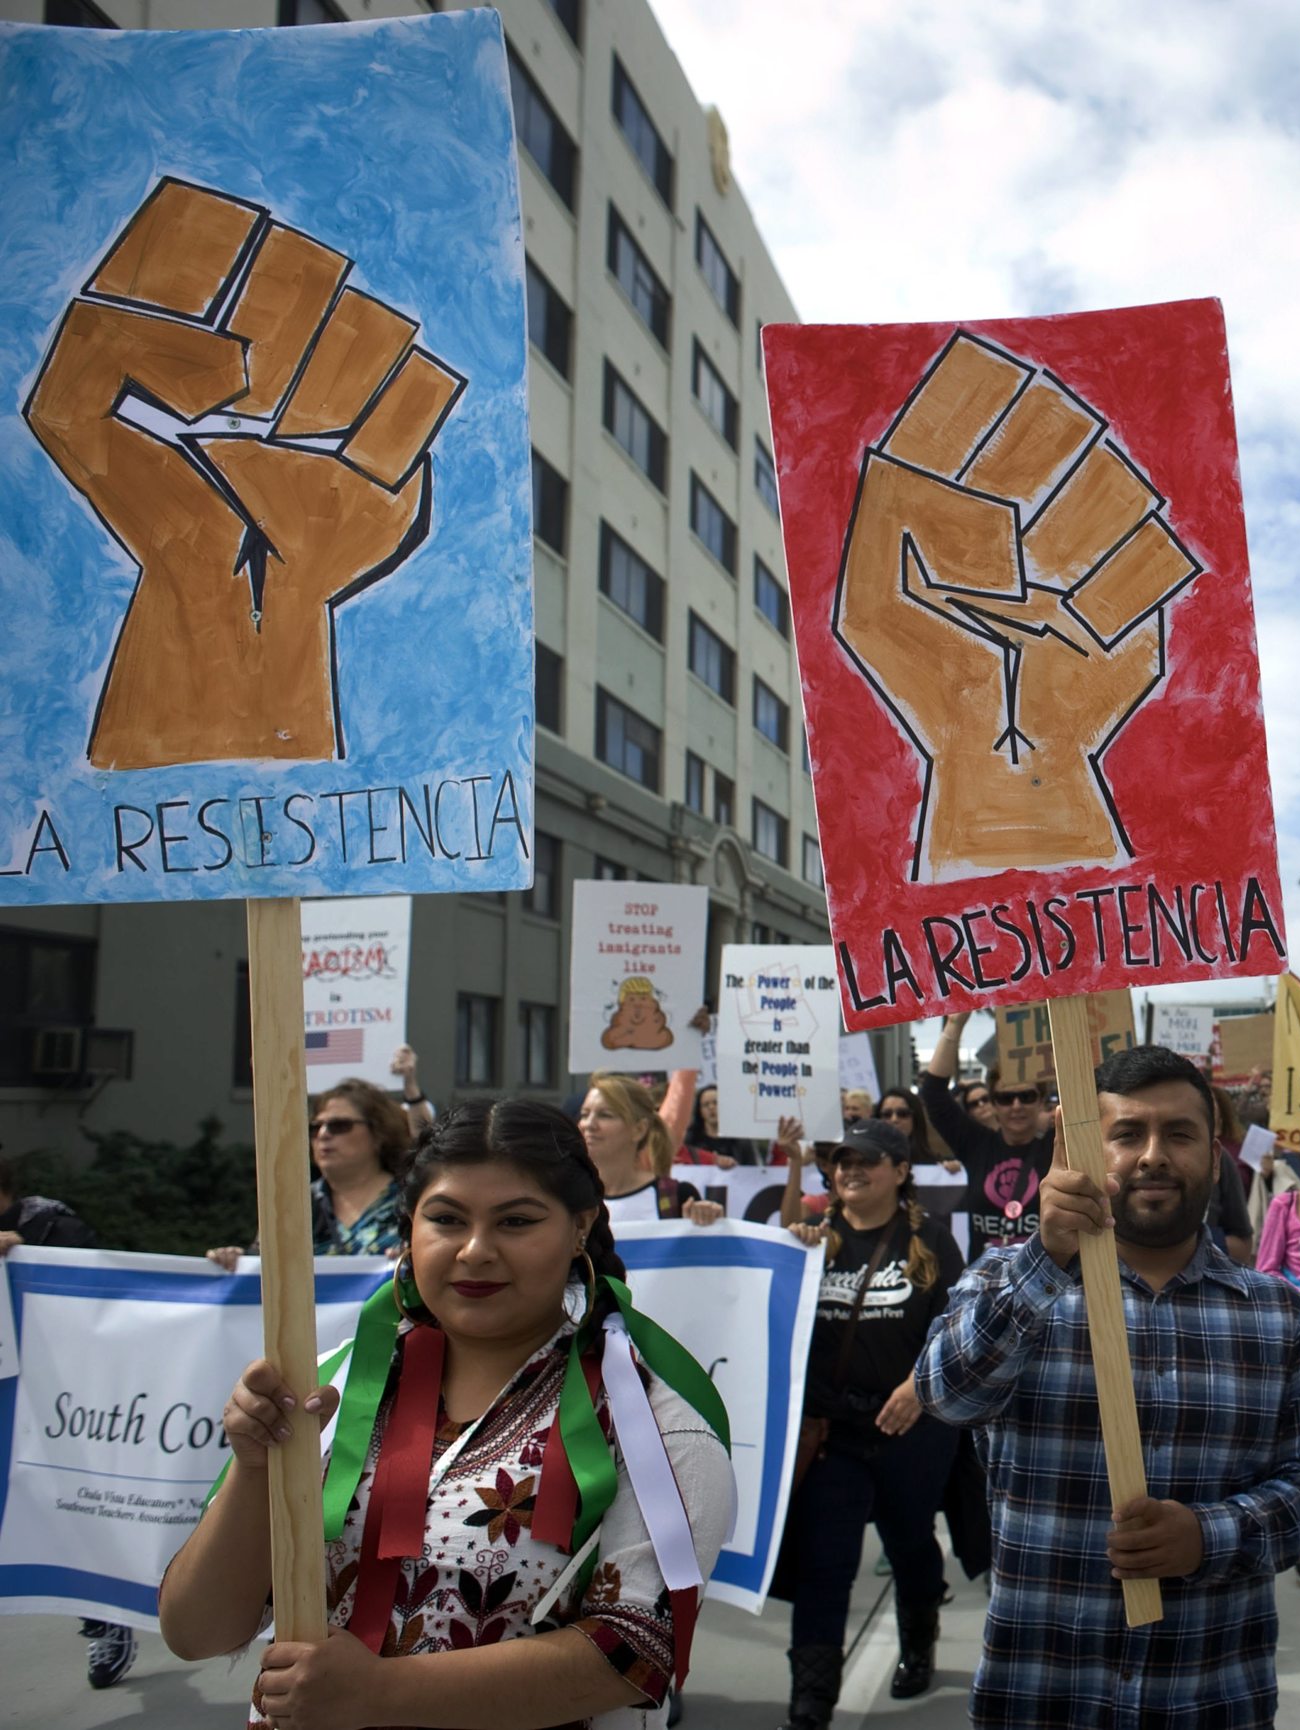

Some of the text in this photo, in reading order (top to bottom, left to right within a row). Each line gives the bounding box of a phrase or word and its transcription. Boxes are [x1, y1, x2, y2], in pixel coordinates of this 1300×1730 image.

[114, 770, 530, 873] RESISTENCIA
[624, 903, 659, 916] STOP
[609, 923, 673, 938] treating
[838, 877, 1286, 1011] LA RESISTENCIA
[624, 961, 656, 973] like
[726, 974, 835, 990] The Power of the
[760, 996, 796, 1012] People
[305, 1007, 392, 1027] TRIOTISM
[744, 1040, 810, 1055] greater than
[742, 1061, 758, 1075] the
[761, 1061, 798, 1076] People
[759, 1083, 796, 1098] Power!
[972, 1213, 1040, 1238] RESIS
[46, 1392, 147, 1444] South
